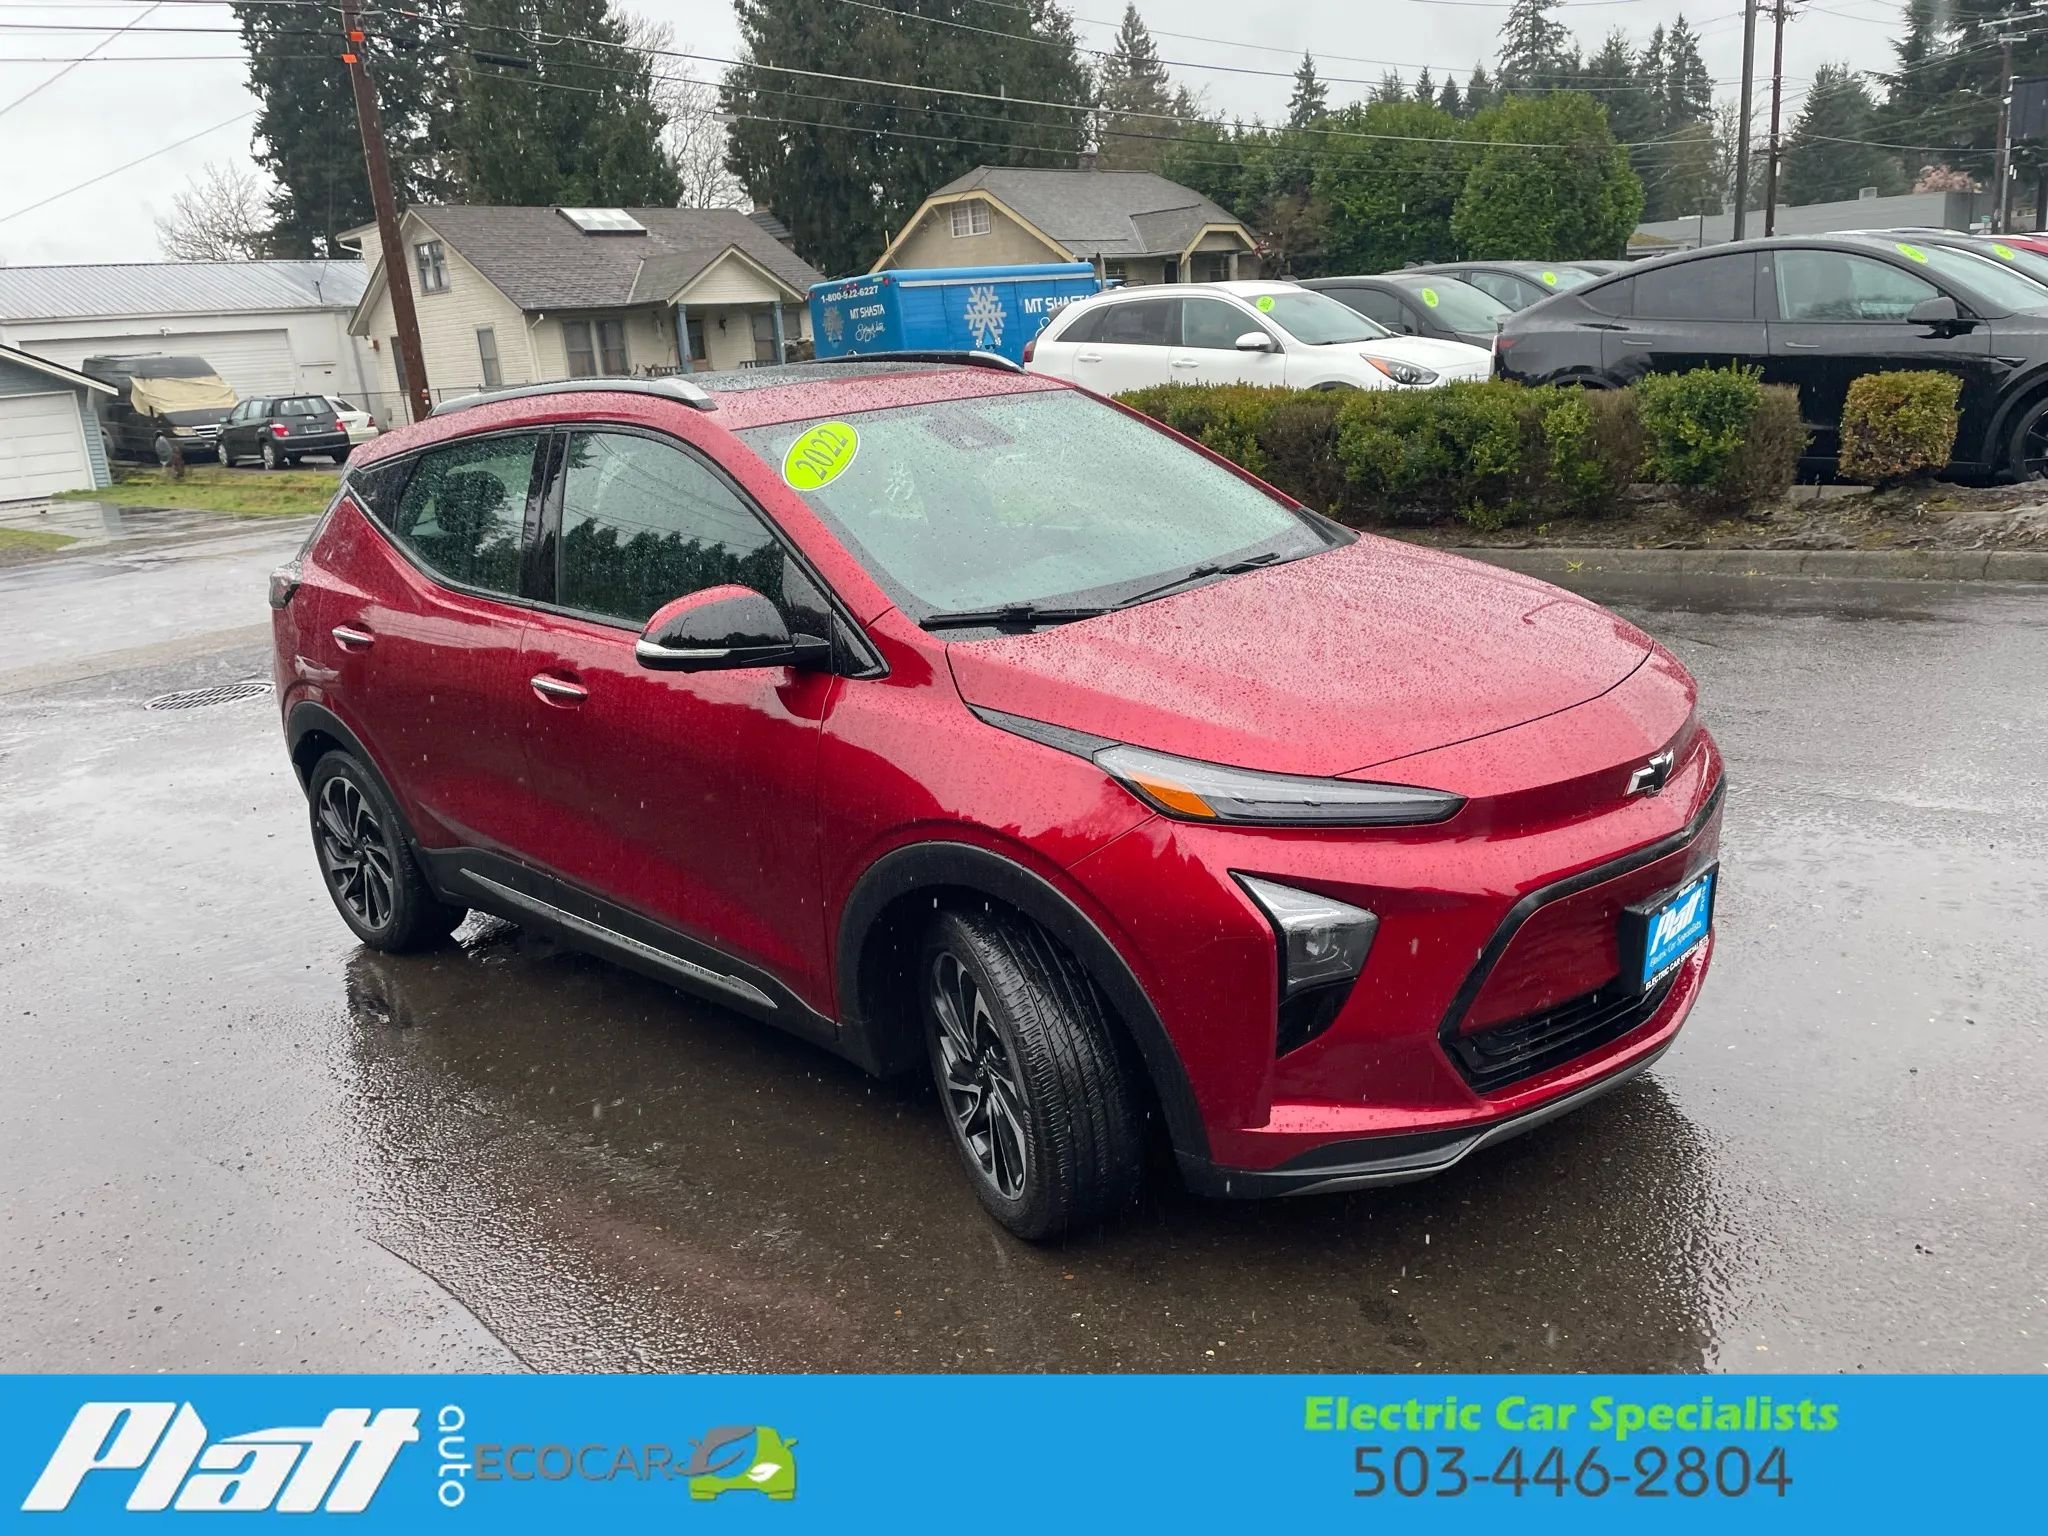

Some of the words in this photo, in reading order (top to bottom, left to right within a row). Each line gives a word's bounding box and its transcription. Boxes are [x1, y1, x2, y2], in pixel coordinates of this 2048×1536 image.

[849, 308, 859, 320] MT
[860, 303, 885, 318] SHASTA
[1024, 297, 1043, 314] MT
[1045, 294, 1091, 312] SHA
[795, 429, 849, 481] 2022
[1669, 957, 1681, 971] CAR
